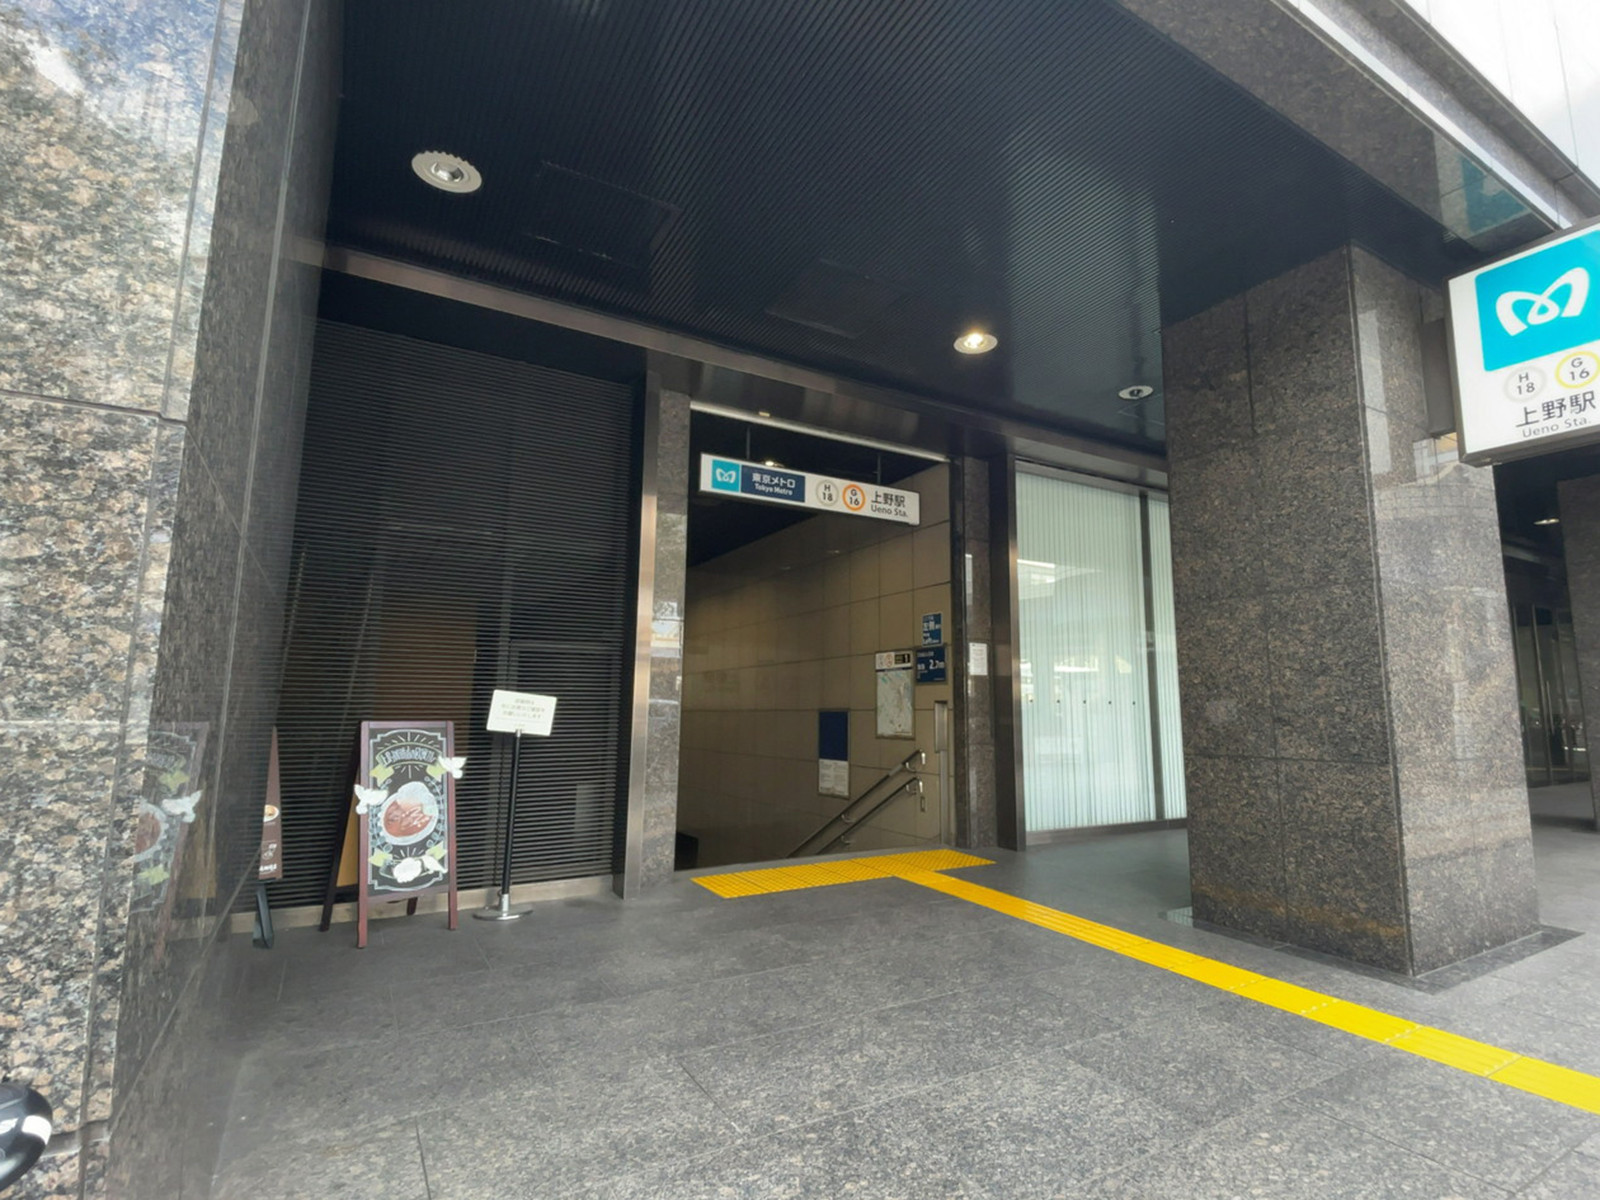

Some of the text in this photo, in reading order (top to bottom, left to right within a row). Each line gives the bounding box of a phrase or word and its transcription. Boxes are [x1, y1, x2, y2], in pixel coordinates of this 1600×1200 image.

[1571, 357, 1583, 368] G
[1518, 372, 1529, 383] H
[1569, 368, 1590, 381] 16
[1517, 382, 1535, 395] 18
[1515, 390, 1596, 428] 上野駅
[1522, 423, 1559, 438] Ueno
[752, 472, 796, 488] 東京メトロ
[754, 483, 793, 496] Tokyo Metro
[823, 484, 831, 492] H
[850, 488, 857, 496] G
[822, 492, 833, 502] 18
[850, 496, 860, 506] 16
[871, 490, 906, 508] 上野駅
[870, 503, 893, 515] Ueno
